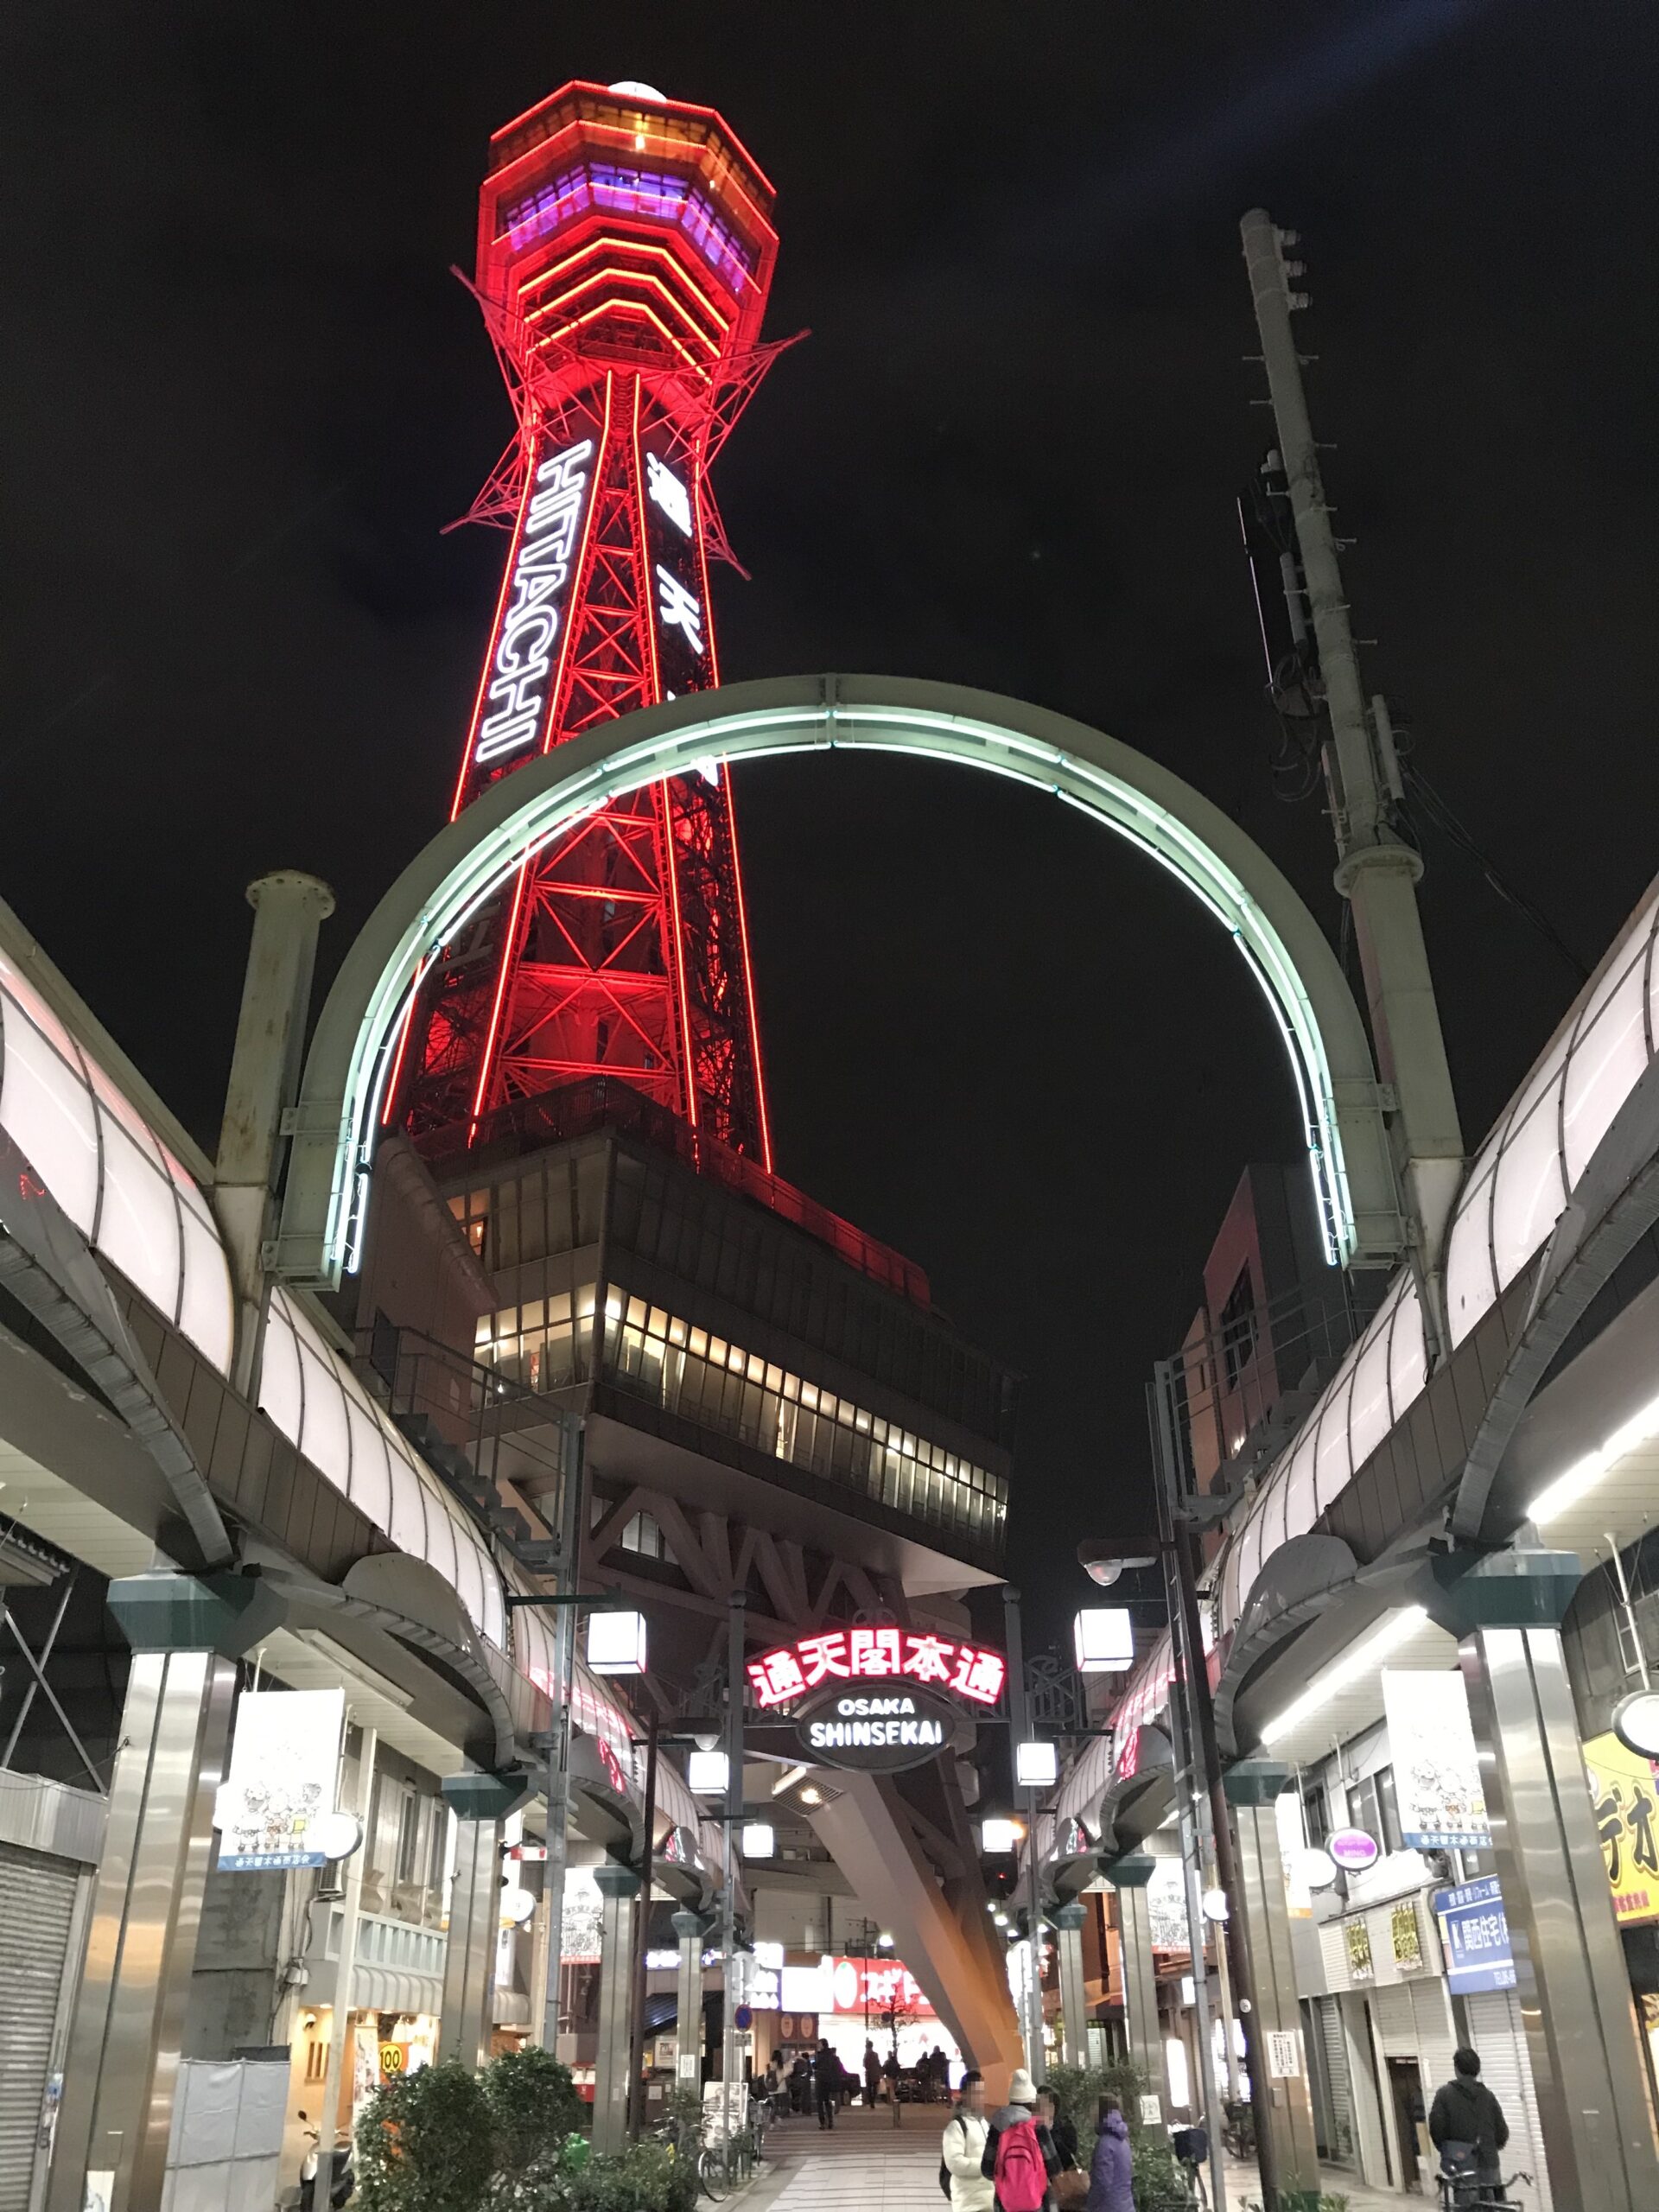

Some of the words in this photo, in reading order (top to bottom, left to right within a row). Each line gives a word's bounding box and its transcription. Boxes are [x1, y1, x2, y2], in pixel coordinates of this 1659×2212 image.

[474, 439, 592, 763] HITACHI
[747, 1628, 1005, 1708] 通天閣本通
[837, 1697, 915, 1717] OSAKA
[810, 1719, 943, 1747] SHINSEKAI
[380, 2050, 400, 2072] 100
